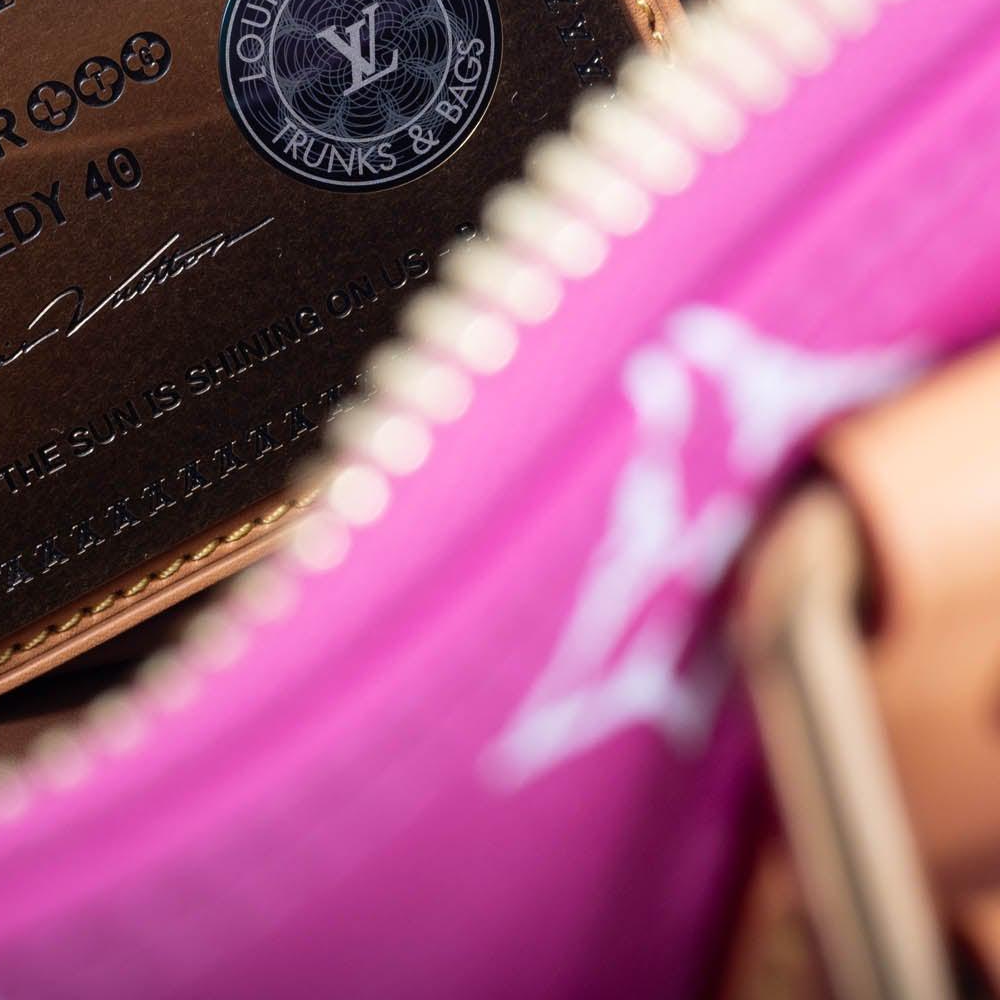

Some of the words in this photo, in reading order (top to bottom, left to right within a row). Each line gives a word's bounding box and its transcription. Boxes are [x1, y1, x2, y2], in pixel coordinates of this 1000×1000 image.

[84, 147, 144, 202] 40
[271, 117, 397, 177] TRUNKS
[408, 124, 440, 155] &
[435, 38, 485, 125] BAGS
[67, 400, 142, 458] SUN
[142, 380, 183, 419] IS
[184, 305, 324, 397] SHINING
[327, 276, 378, 319] ON
[379, 247, 431, 290] US
